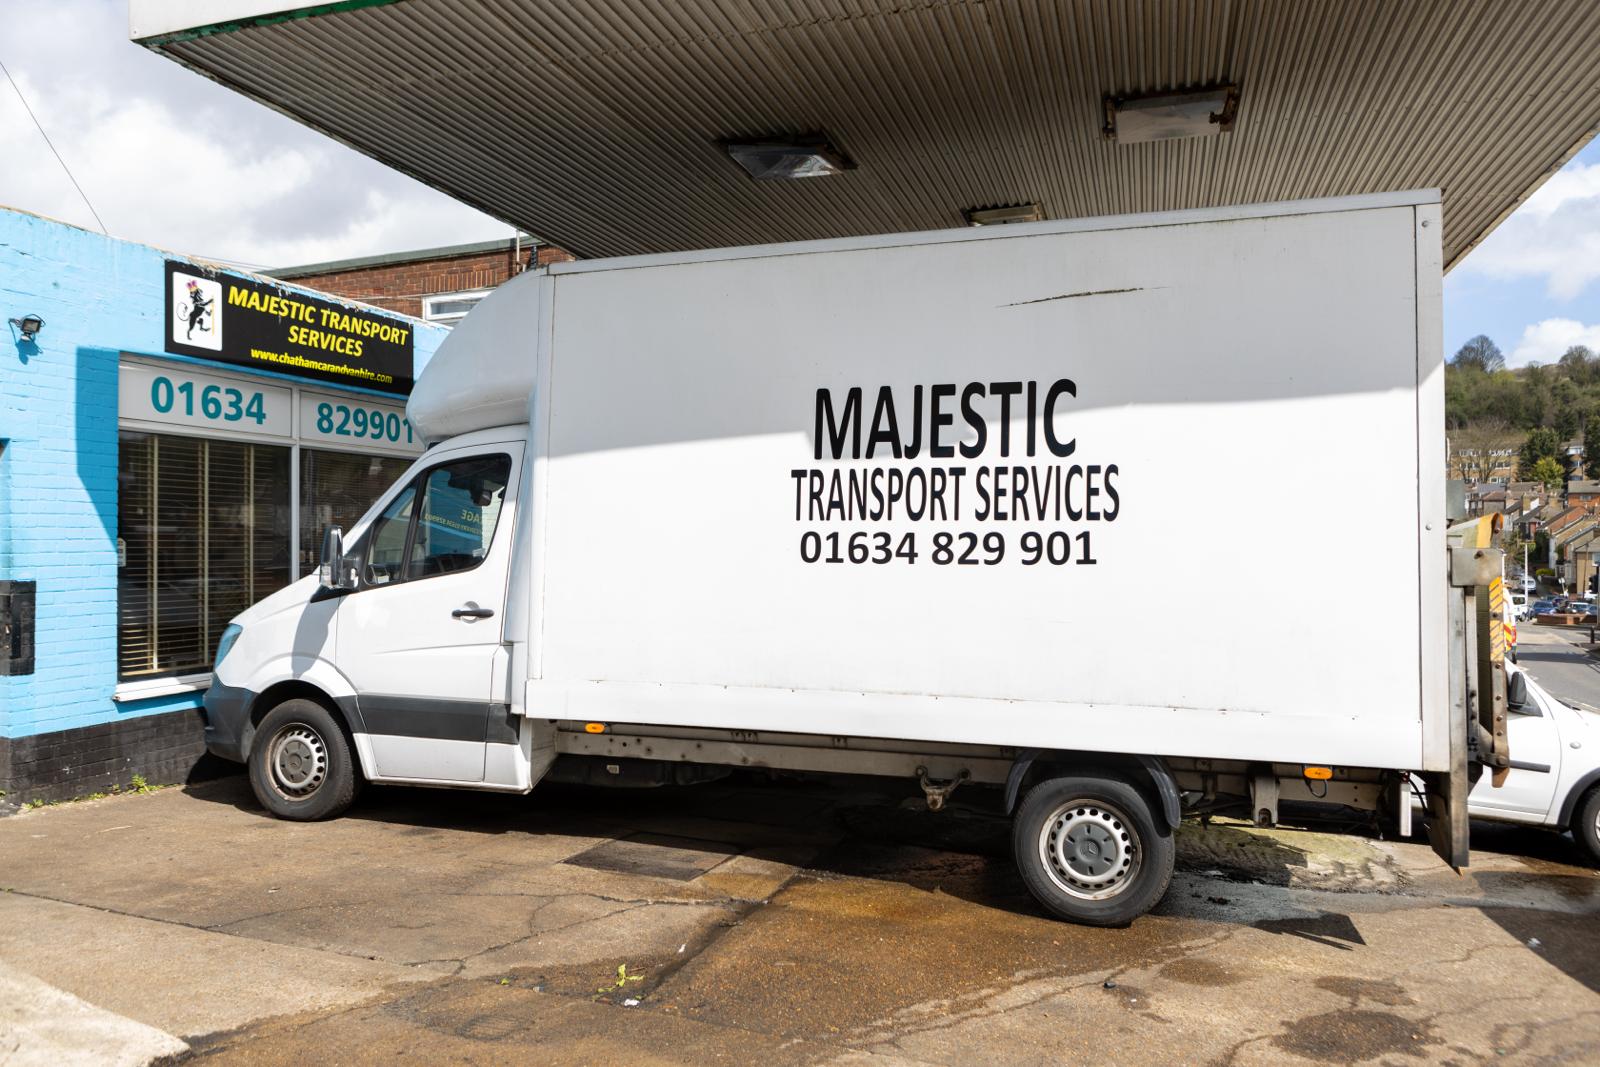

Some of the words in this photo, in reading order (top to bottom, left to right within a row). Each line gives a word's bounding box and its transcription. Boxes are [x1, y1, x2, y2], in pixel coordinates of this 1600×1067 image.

[227, 285, 317, 324] MAJESTIC
[320, 308, 409, 346] TRANSPORT
[287, 325, 363, 357] SERVICES
[250, 348, 393, 384] www.chathamcarandvanhire.com
[151, 376, 267, 425] 01634
[316, 402, 413, 444] 829901
[814, 378, 1077, 460] MAJESTIC
[791, 466, 966, 522] TRANSPORT
[974, 463, 1120, 522] SERVICES
[800, 531, 918, 565] 01634
[931, 531, 1005, 566] 829
[1020, 530, 1097, 566] 901
